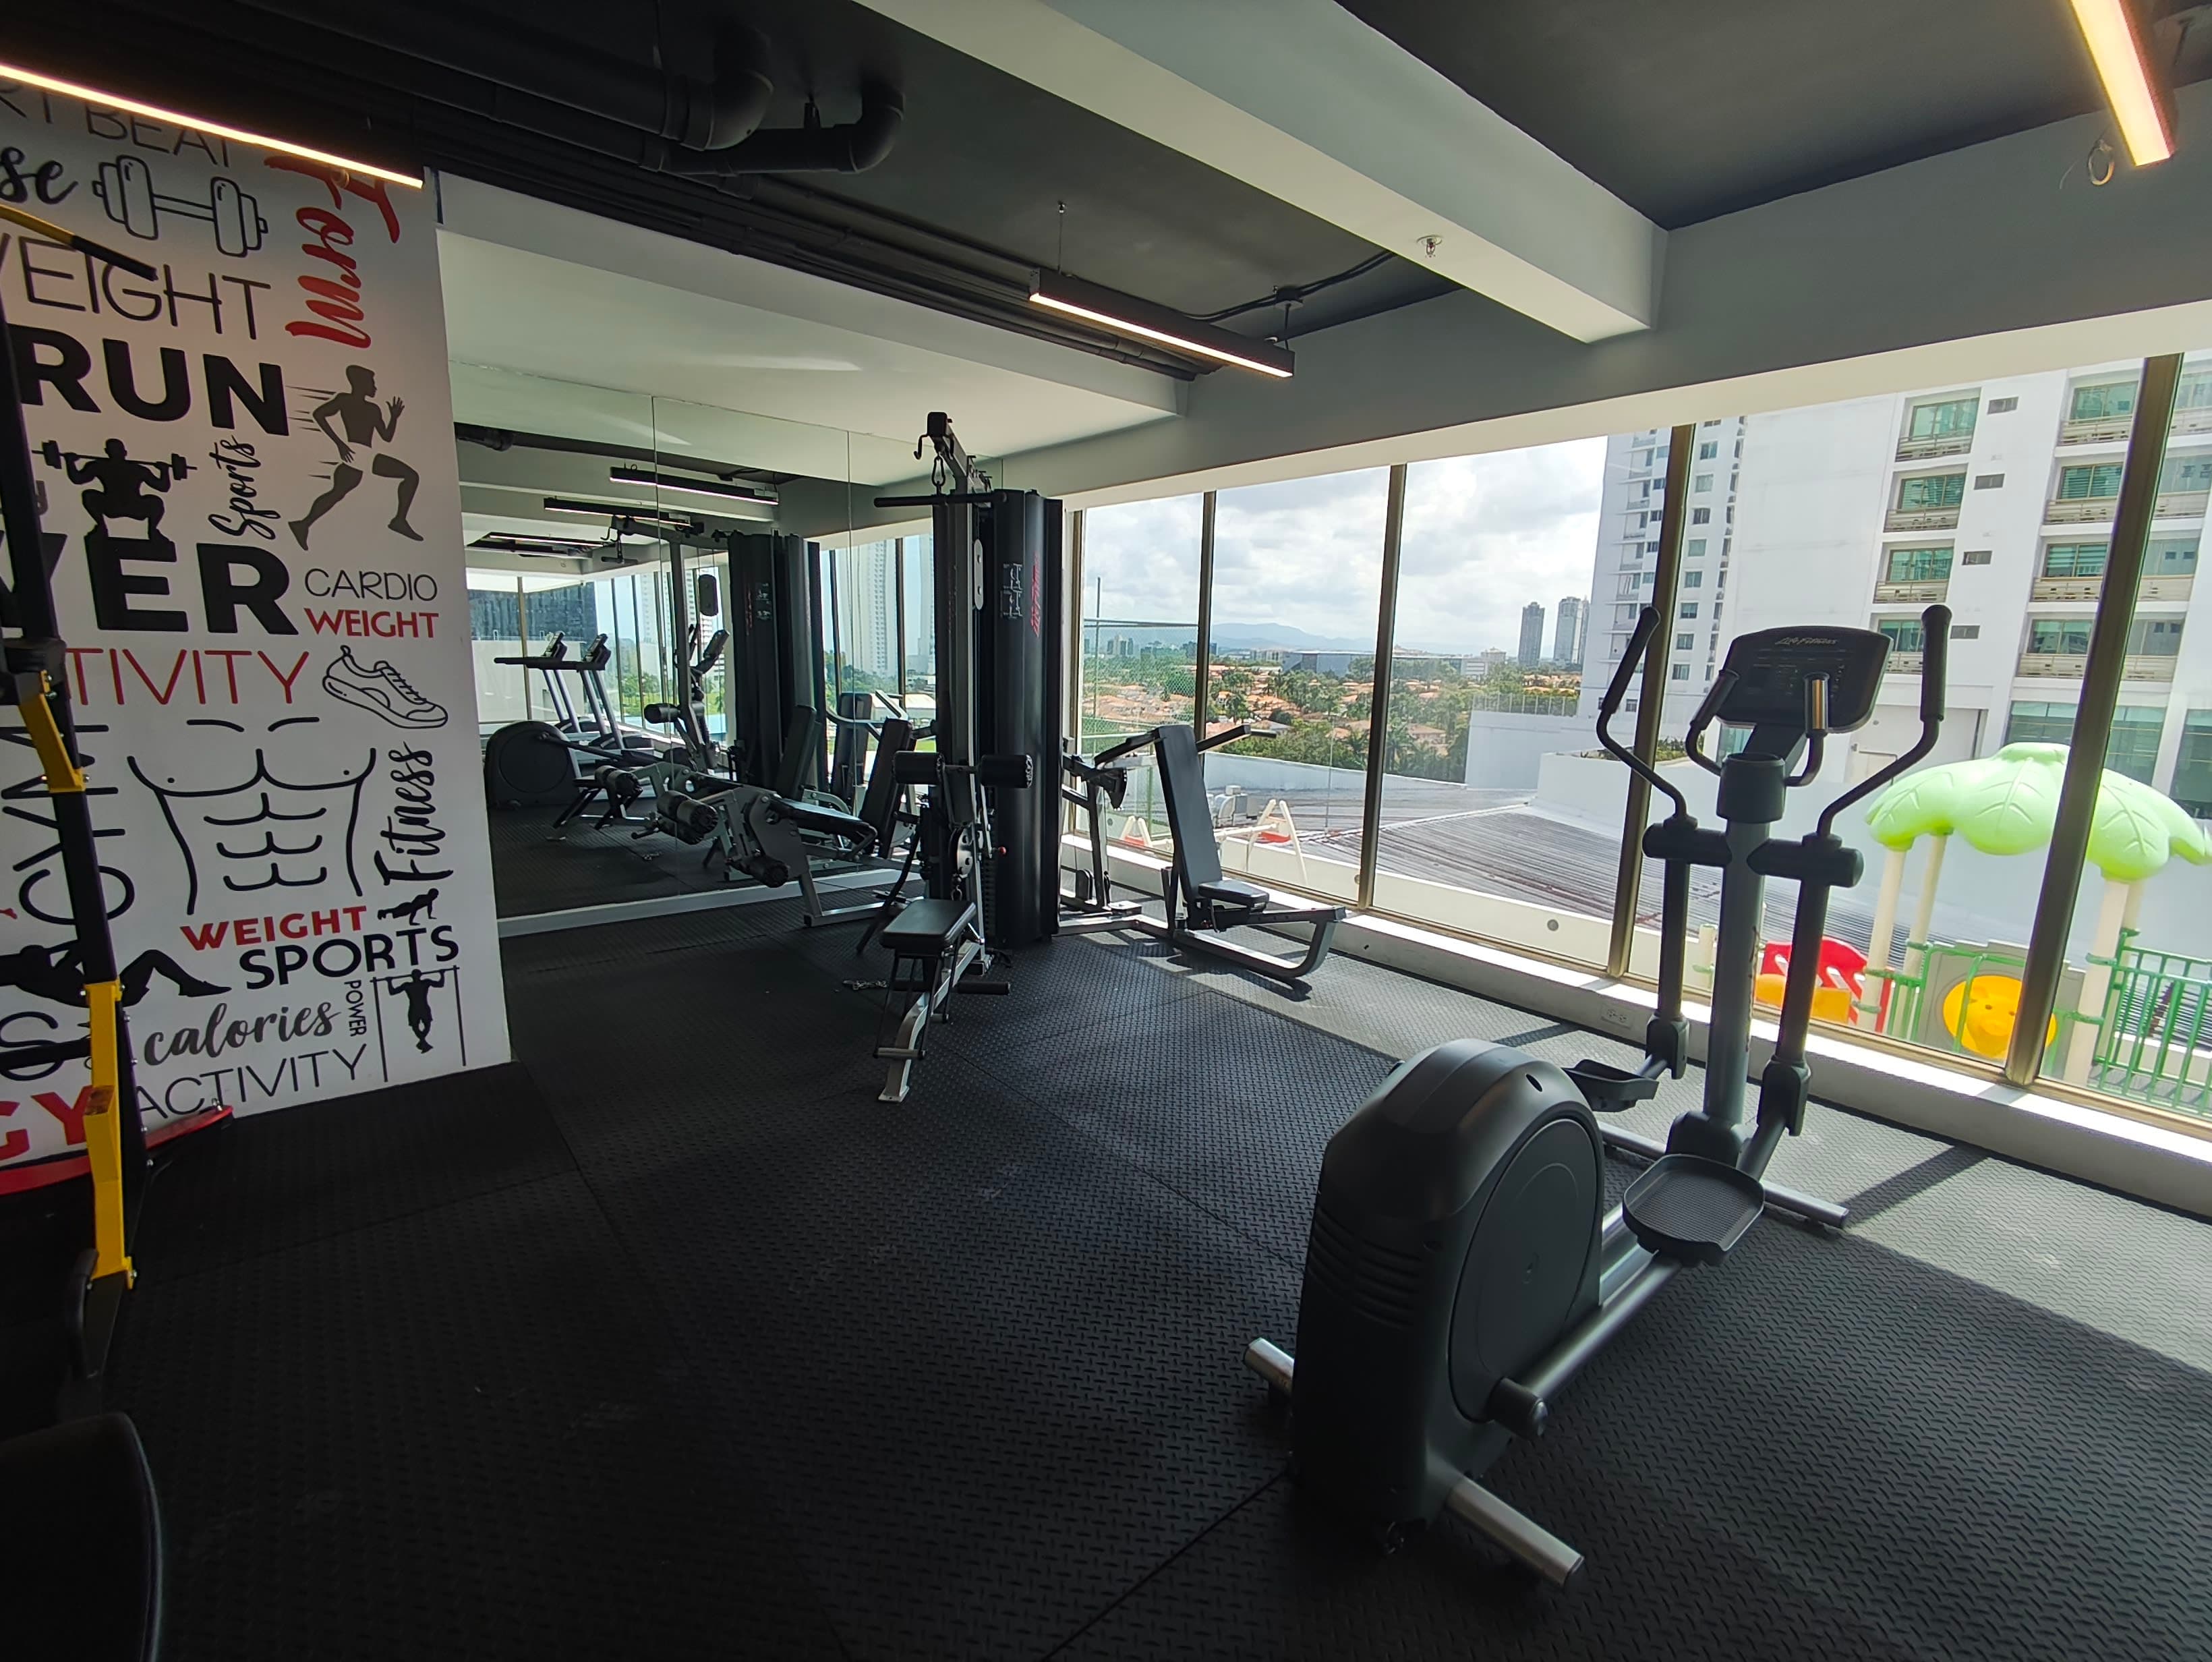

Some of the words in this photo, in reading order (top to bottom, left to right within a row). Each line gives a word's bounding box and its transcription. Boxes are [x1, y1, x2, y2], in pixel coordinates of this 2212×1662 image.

[0, 233, 271, 341] EIGHT
[5, 322, 290, 436] RUN
[208, 435, 281, 540] Sports
[304, 567, 438, 601] CARDIO
[303, 607, 440, 639] WEIGHT
[374, 741, 454, 886] Fitness
[180, 905, 368, 952] WEIGHT
[238, 924, 459, 990] SPORTS
[143, 1002, 343, 1066] calories
[344, 979, 368, 1037] POWER
